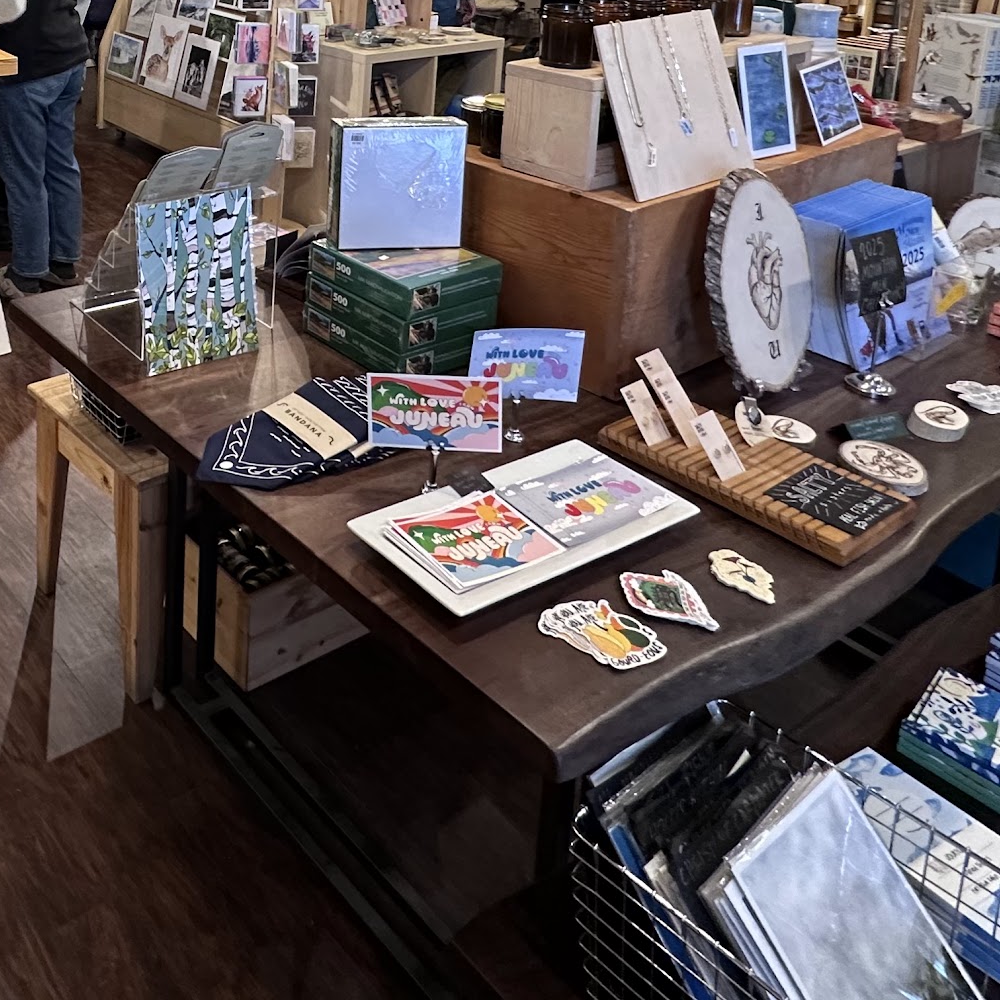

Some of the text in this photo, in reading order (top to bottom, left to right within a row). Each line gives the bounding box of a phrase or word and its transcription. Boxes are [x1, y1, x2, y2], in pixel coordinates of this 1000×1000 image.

[902, 246, 925, 267] 2025
[335, 261, 352, 276] 500
[332, 293, 348, 307] 500
[330, 323, 346, 338] 500
[486, 346, 544, 359] WITH LOVE
[483, 356, 568, 382] JUNEAU
[389, 393, 417, 406] WITH
[420, 397, 456, 408] LOVE
[285, 408, 322, 438] BANDANA
[389, 406, 483, 431] JUNEAU
[547, 480, 603, 503] WITH LOVE
[564, 479, 641, 516] JUNEAU
[431, 523, 486, 545] WITH LOVE
[448, 525, 523, 561] JUNEAU
